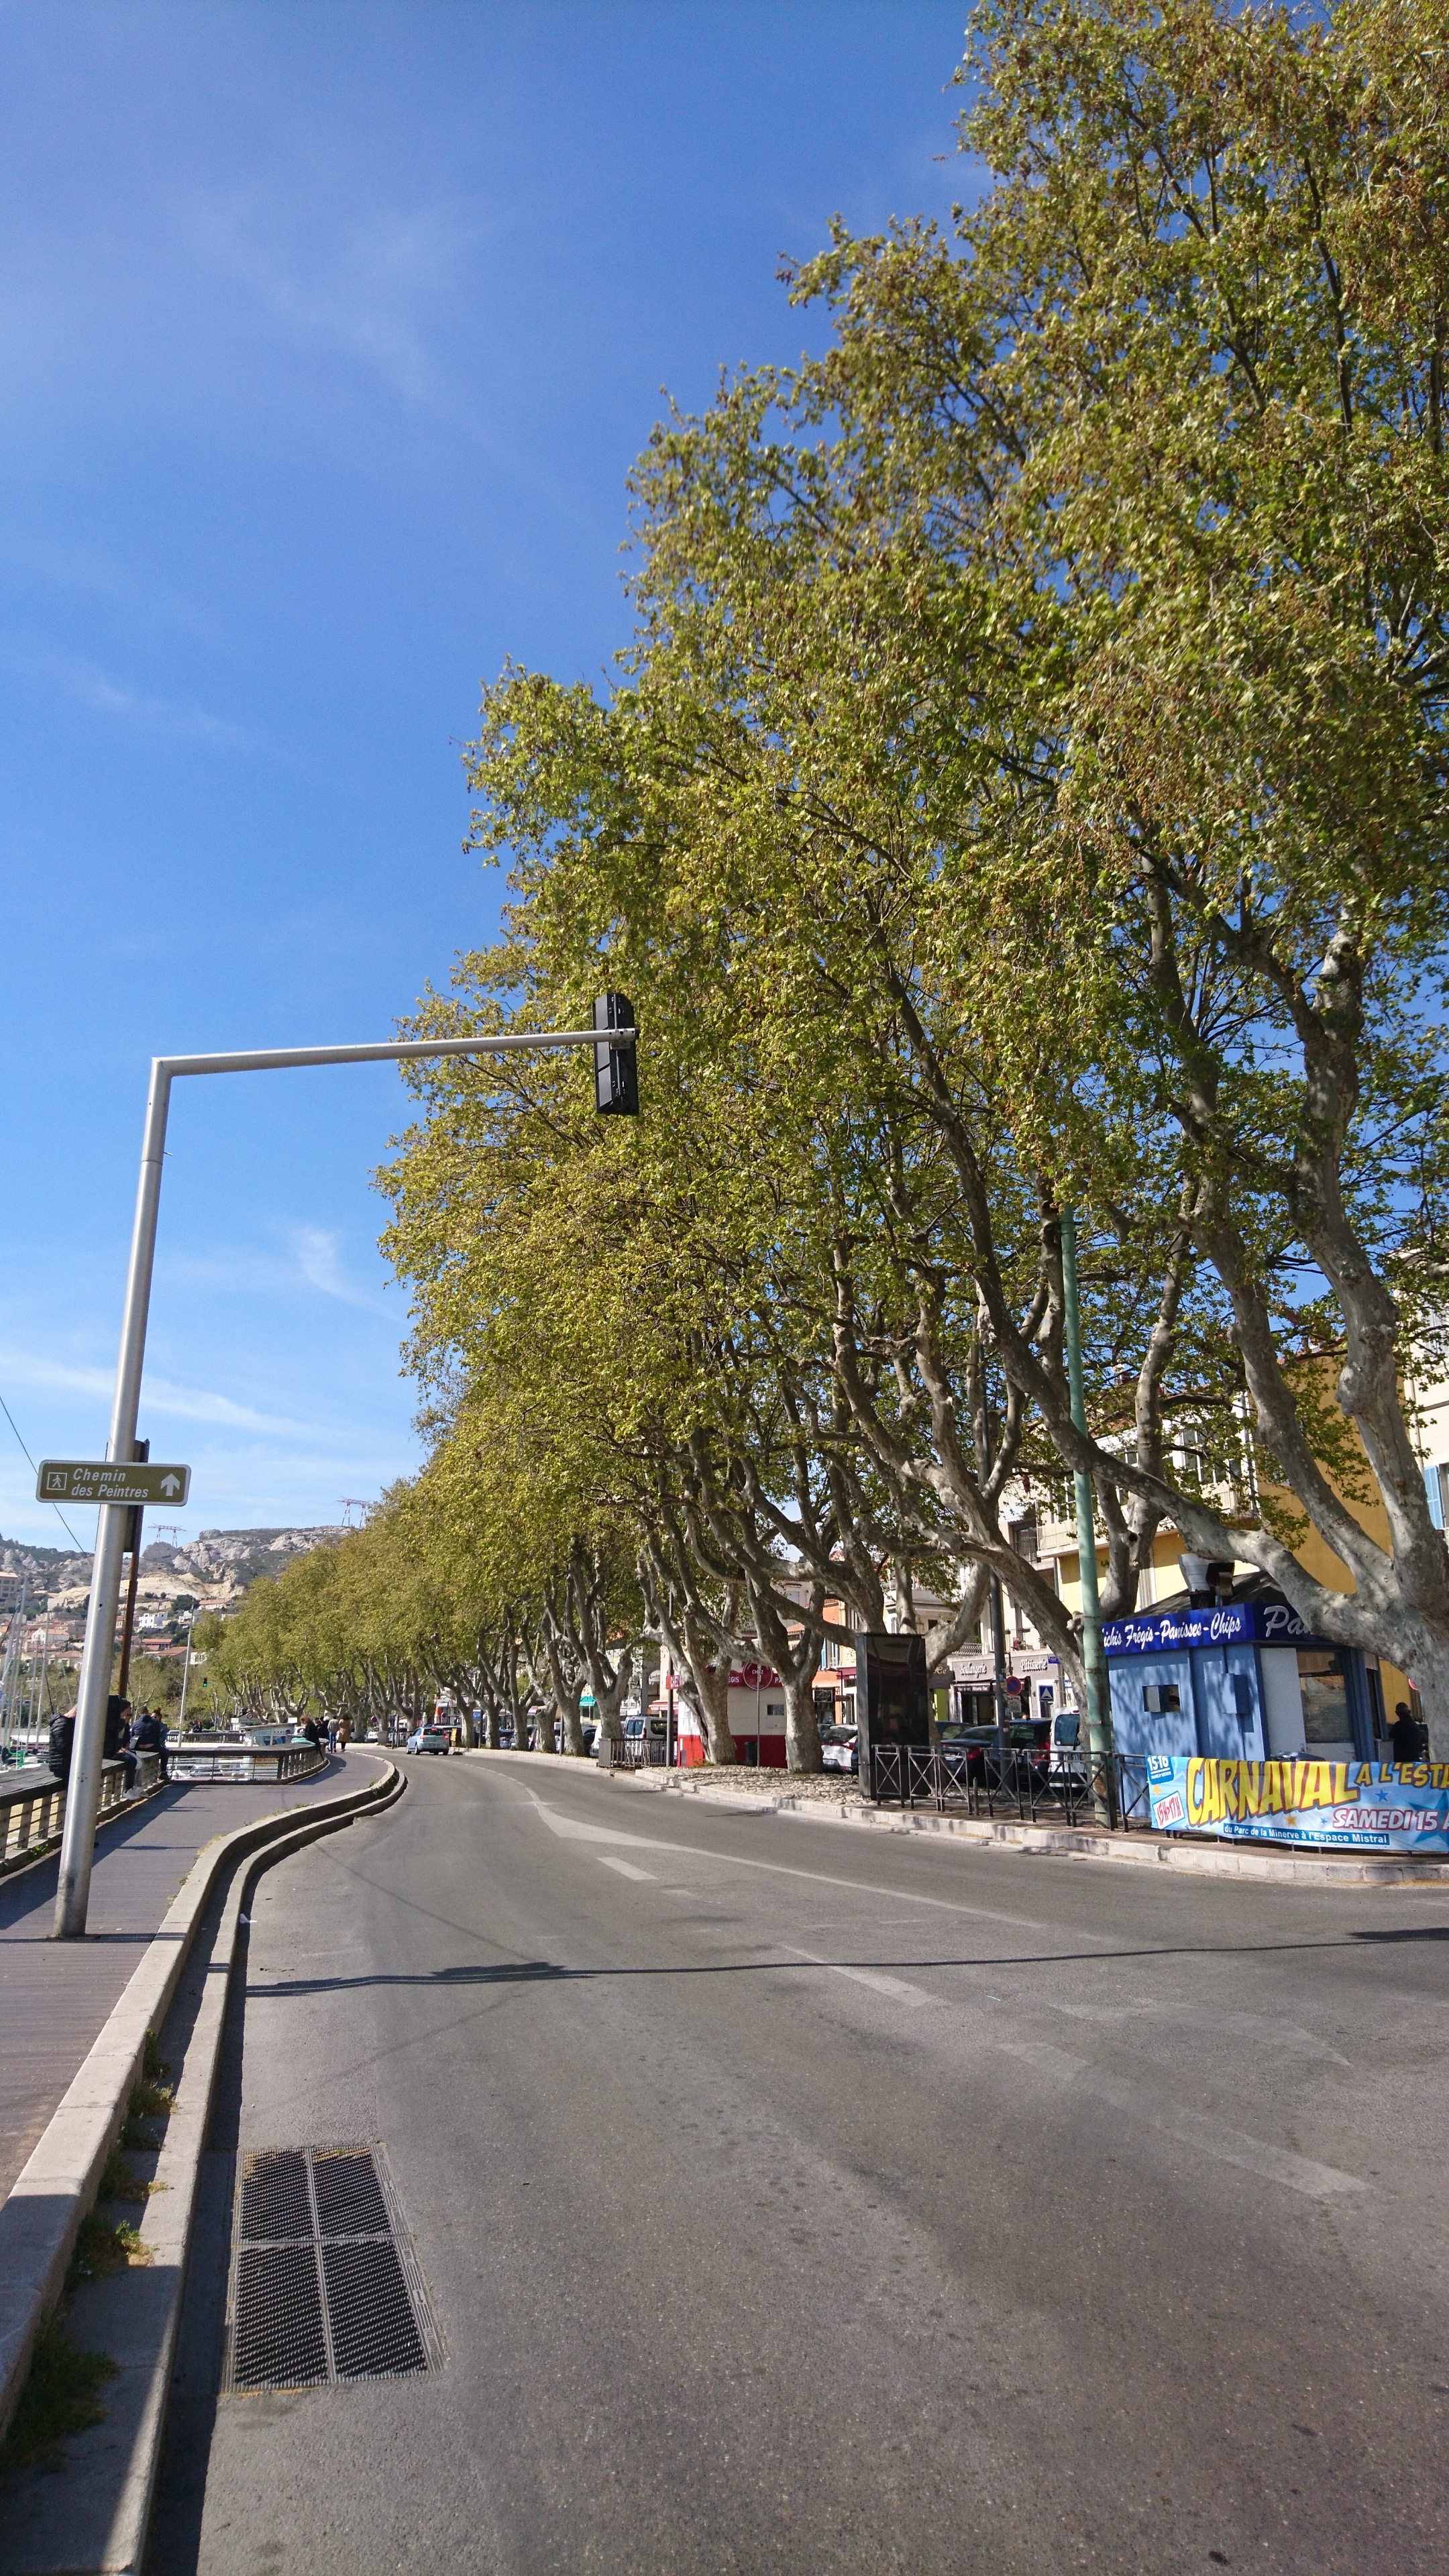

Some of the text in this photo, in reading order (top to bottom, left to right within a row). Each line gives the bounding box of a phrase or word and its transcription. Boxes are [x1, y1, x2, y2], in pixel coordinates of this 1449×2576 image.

[73, 1468, 126, 1482] Chemin
[71, 1484, 149, 1498] des Peintres
[959, 1662, 987, 1678] Boulangerie
[1020, 1658, 1048, 1672] Pâtisserie
[1186, 1756, 1360, 1827] CARNAVAL
[1332, 1807, 1413, 1831] SAMEDI
[1415, 1811, 1440, 1832] 15
[1224, 1825, 1387, 1843] du Parc de la Minerve à l'Espace Mistral
